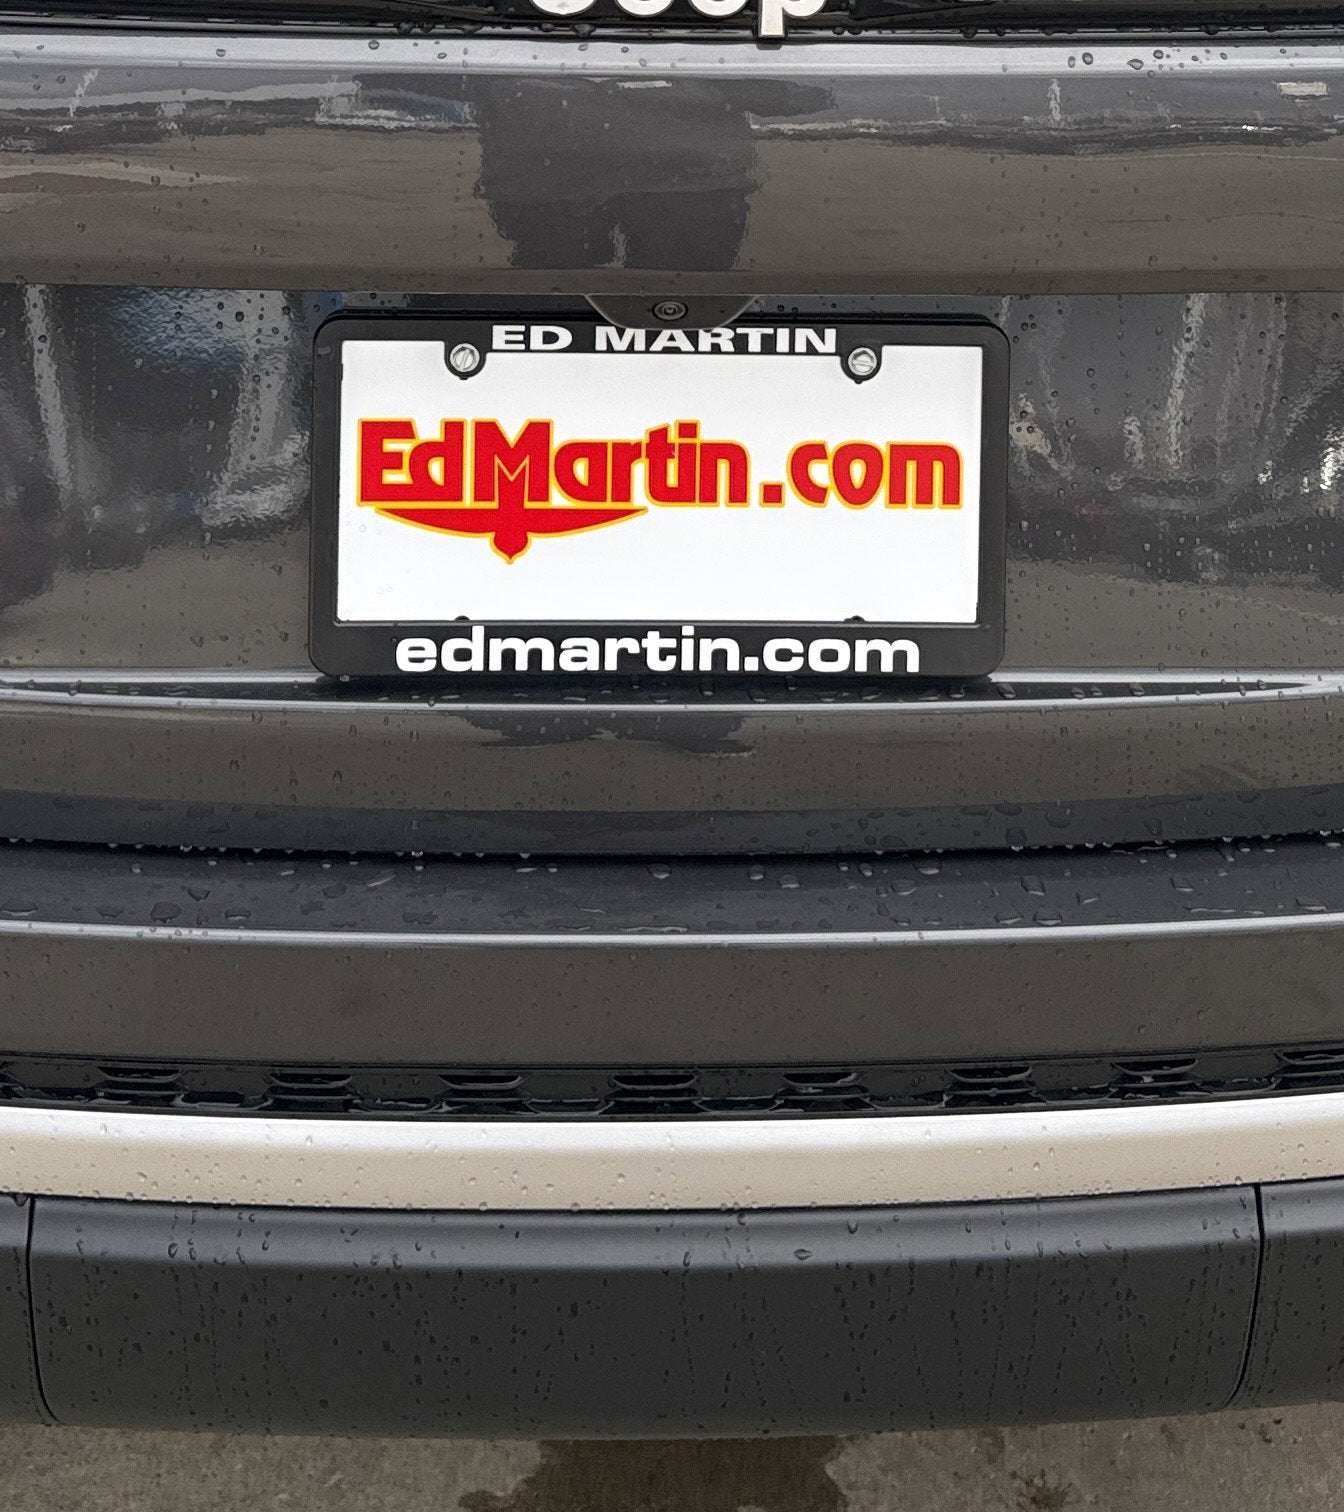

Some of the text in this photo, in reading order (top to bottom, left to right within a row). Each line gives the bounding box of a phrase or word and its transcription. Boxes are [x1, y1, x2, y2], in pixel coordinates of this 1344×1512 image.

[492, 324, 837, 353] ED MARTIN
[355, 417, 964, 509] EdMartin.com
[394, 625, 921, 673] edmartin.com
